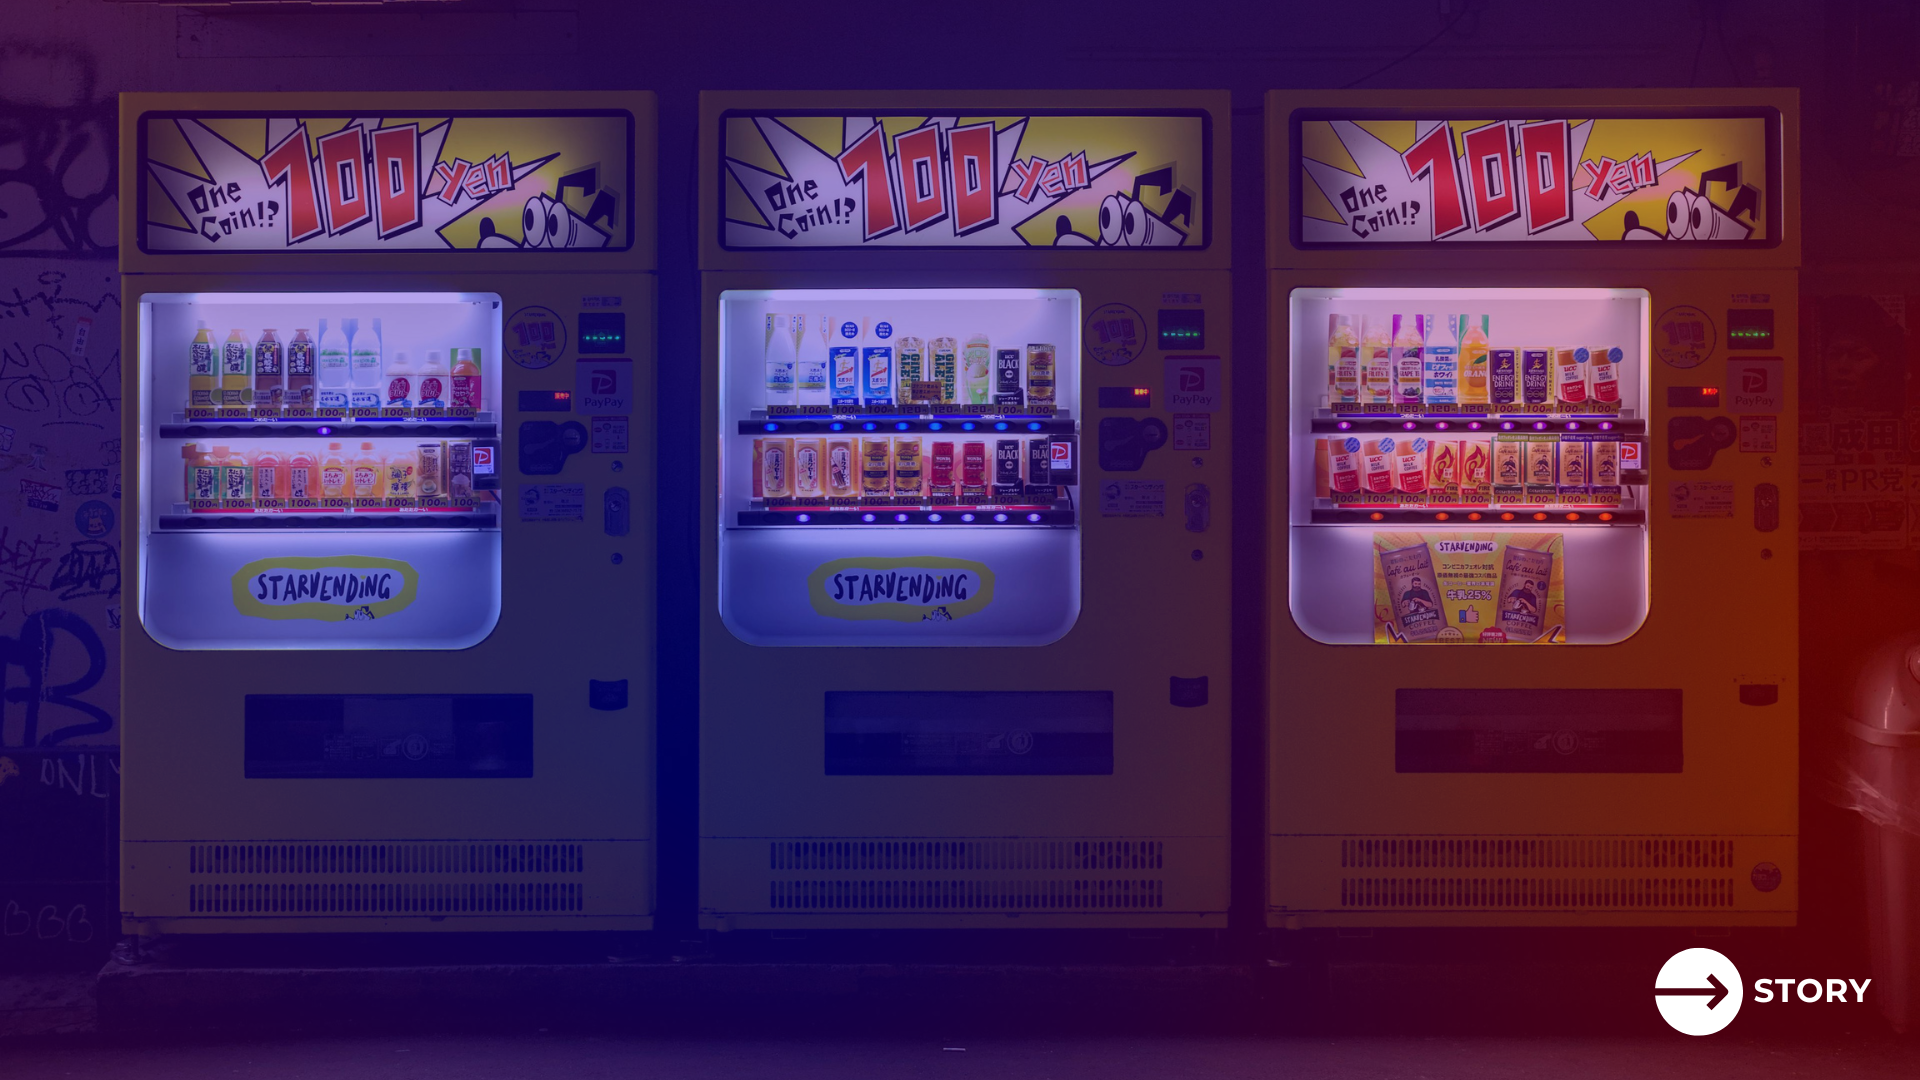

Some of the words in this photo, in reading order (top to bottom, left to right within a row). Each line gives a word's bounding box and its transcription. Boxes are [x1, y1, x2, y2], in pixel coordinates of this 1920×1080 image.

[261, 123, 421, 246] 100
[435, 152, 512, 206] yen
[837, 120, 1000, 242] 100
[1012, 150, 1090, 204] yen
[1401, 119, 1574, 242] 100
[1580, 150, 1658, 201] yen
[185, 181, 242, 215] One
[764, 177, 819, 212] One
[1340, 182, 1387, 214] One
[512, 322, 554, 347] 100
[1092, 318, 1135, 344] 100
[945, 354, 954, 399] GINGER
[998, 359, 1019, 369] BLACK
[585, 398, 624, 408] PayPay
[1173, 394, 1212, 406] PayPay
[1735, 396, 1774, 407] PayPay
[998, 450, 1018, 460] BLACK
[1840, 468, 1904, 492] PR党
[1440, 542, 1493, 552] STARVENDING
[256, 570, 391, 604] STARVENDING
[833, 569, 969, 603] STARVENDING
[1447, 589, 1492, 600] 牛乳25%
